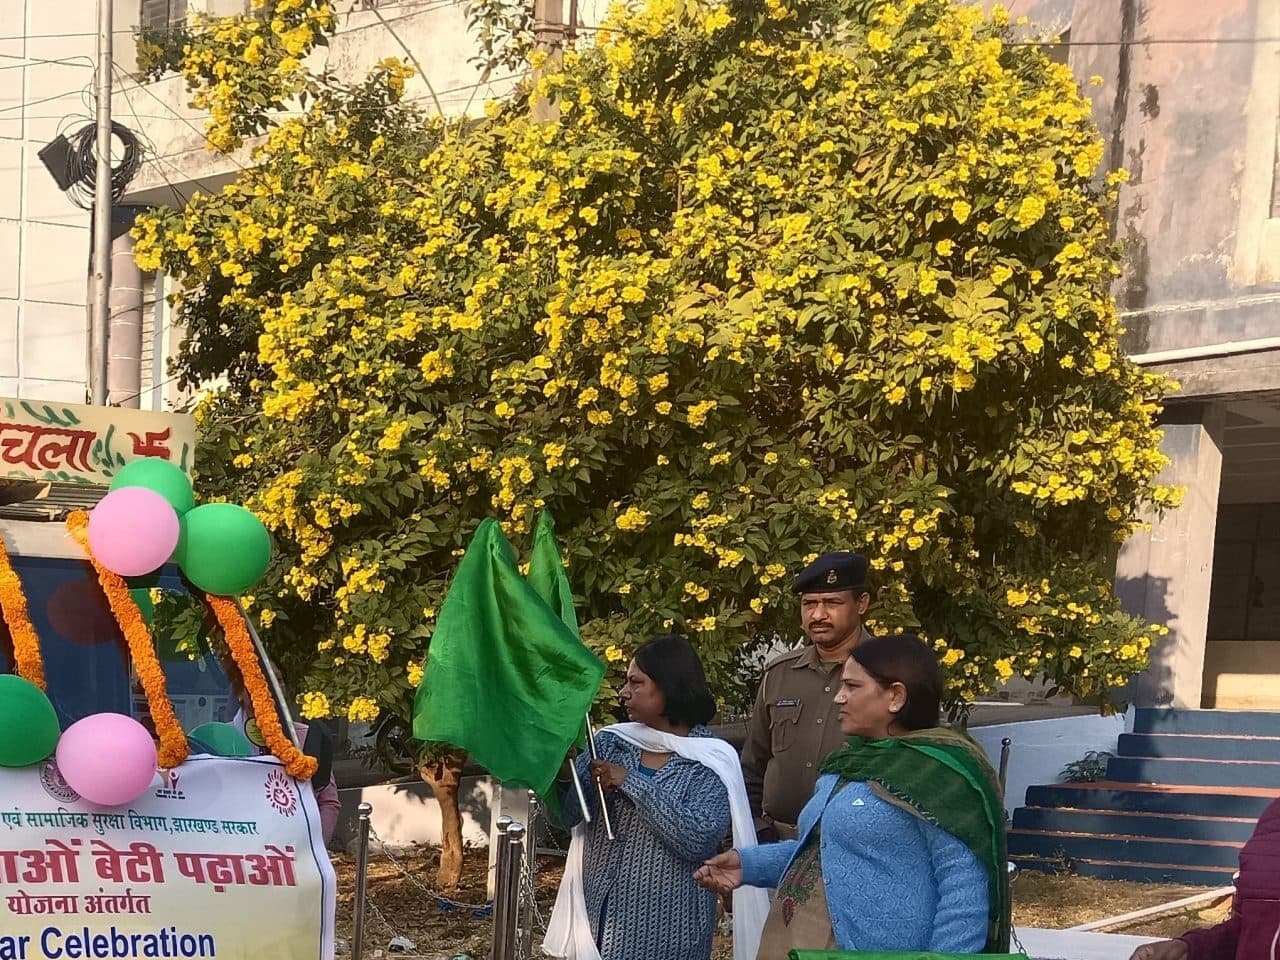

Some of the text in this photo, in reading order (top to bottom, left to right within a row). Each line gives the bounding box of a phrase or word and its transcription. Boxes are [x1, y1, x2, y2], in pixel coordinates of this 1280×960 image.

[1, 807, 22, 830] एवं
[25, 807, 88, 829] सामाजिक
[92, 812, 125, 835] सुरक्षा
[220, 820, 258, 835] सरकार
[90, 840, 165, 883] बेटी
[173, 844, 297, 892] पढ़ाओं
[6, 888, 151, 915] योजना अंतर्गत
[40, 926, 215, 960] Celebration
